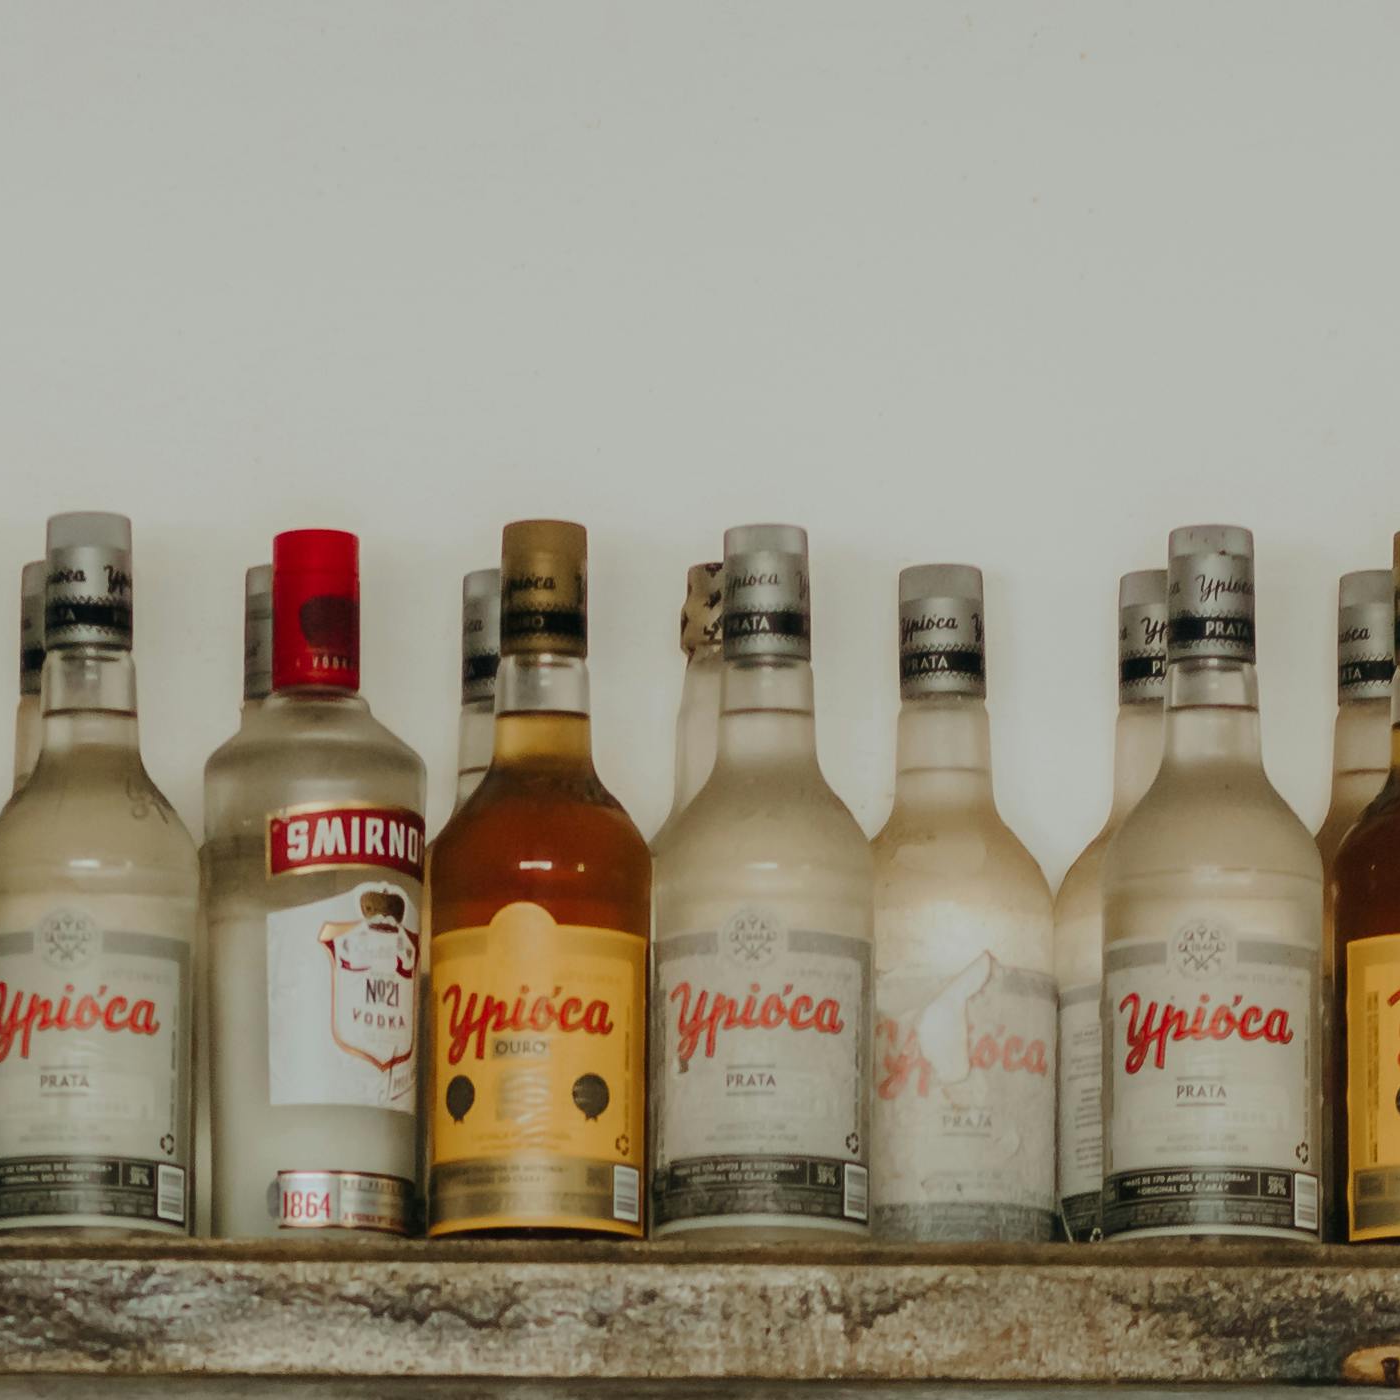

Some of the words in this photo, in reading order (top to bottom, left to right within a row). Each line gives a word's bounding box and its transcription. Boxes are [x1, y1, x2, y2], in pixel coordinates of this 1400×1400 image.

[353, 1007, 407, 1031] VODKA
[443, 984, 614, 1066] Ypióca
[670, 981, 845, 1060] Ypióca
[1119, 992, 1294, 1075] Ypióca
[493, 1038, 549, 1056] OURO
[39, 1073, 91, 1089] PRATA
[725, 1072, 777, 1089] PRATA
[1176, 1082, 1228, 1100] PRATA
[282, 1190, 332, 1219] 1864
